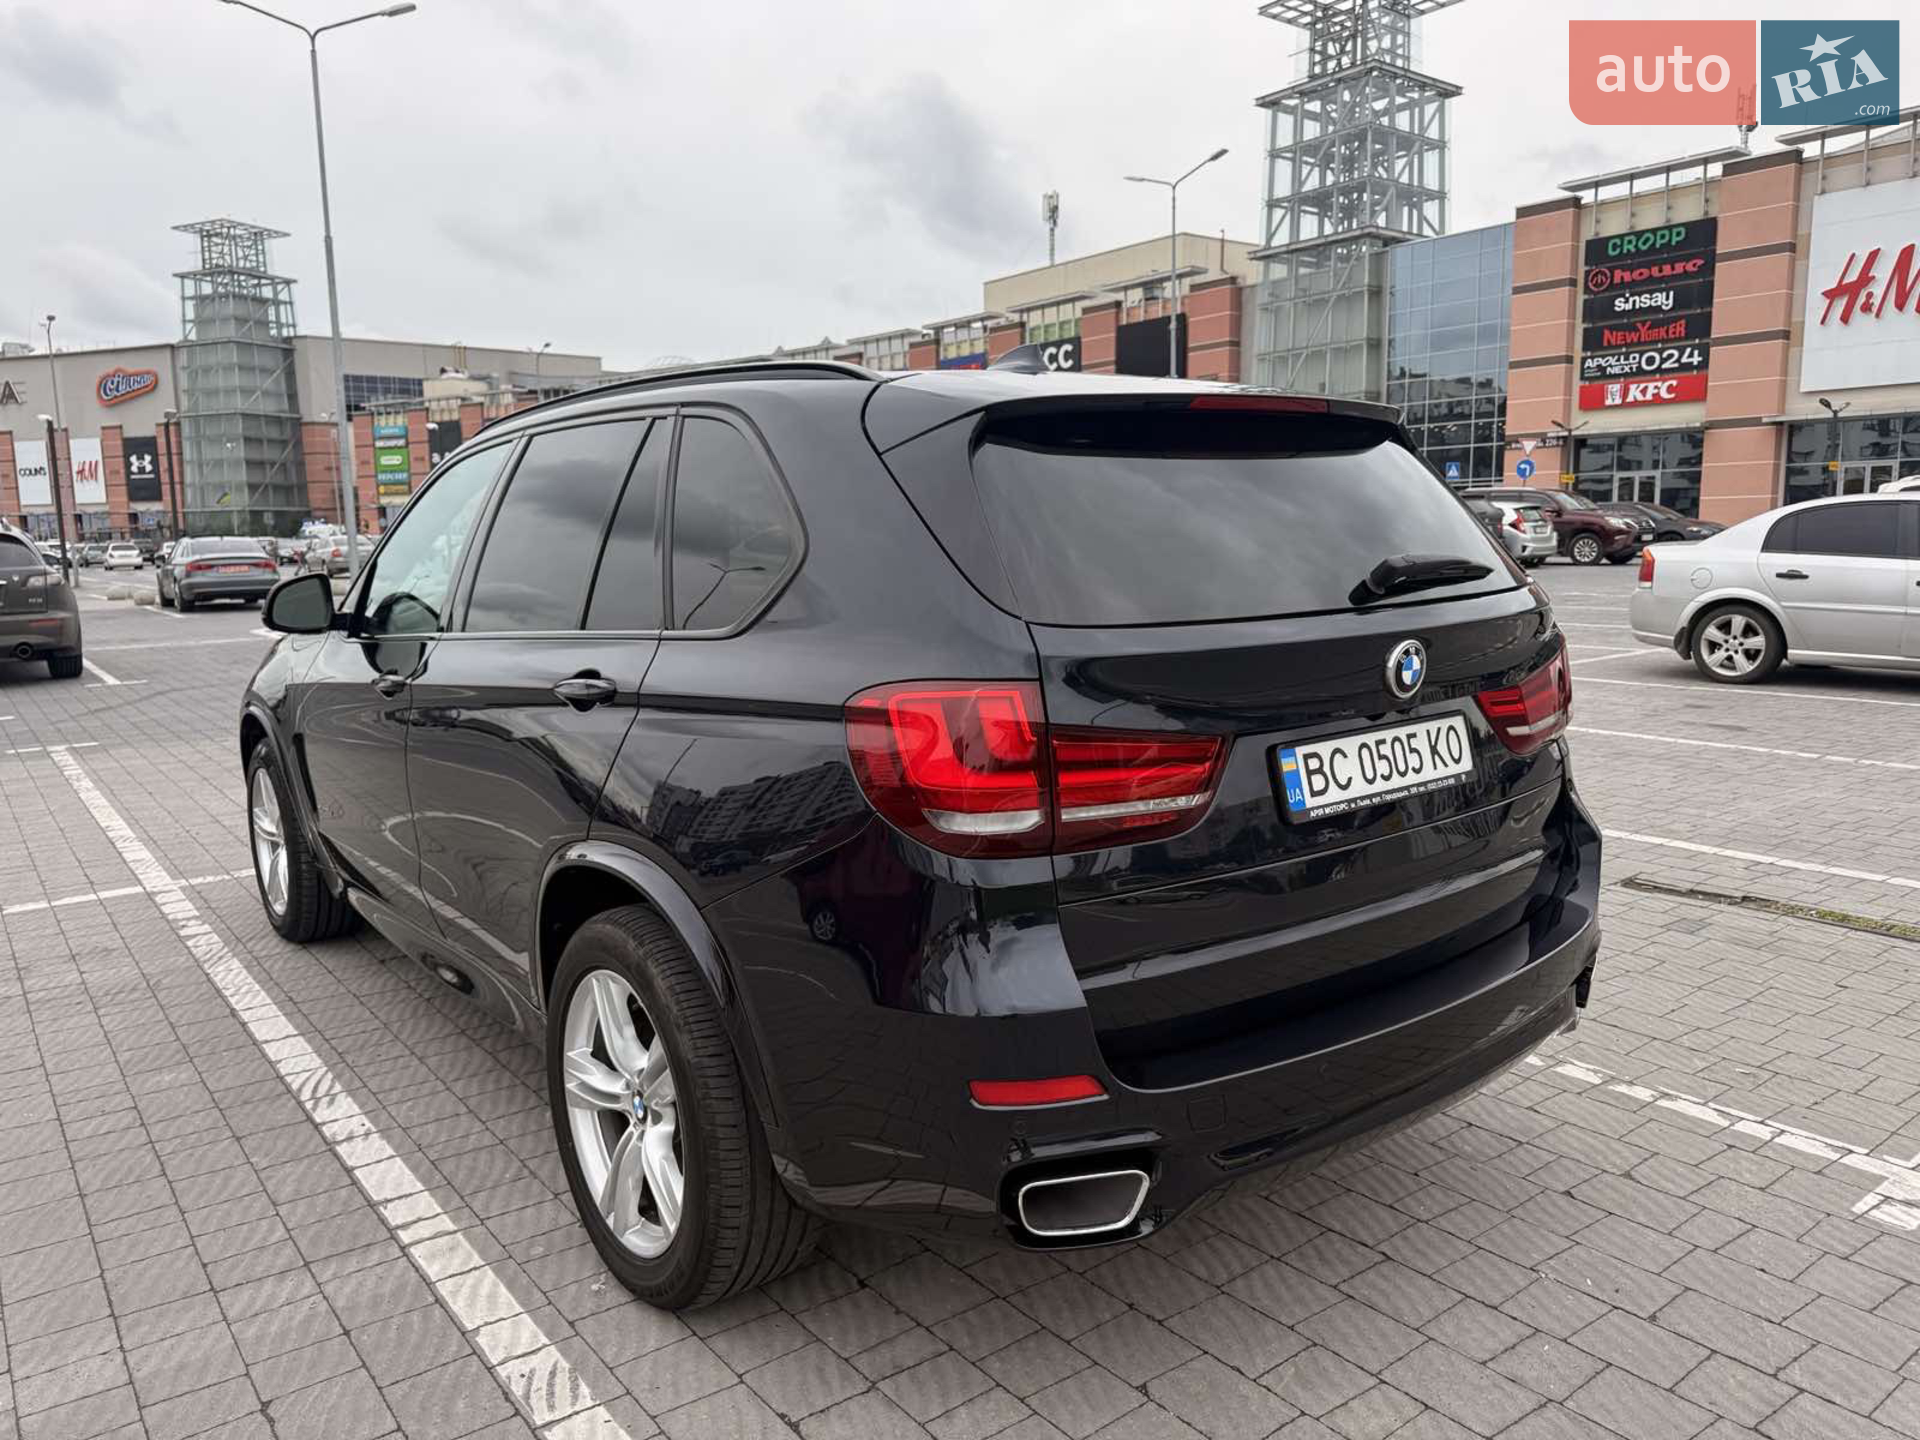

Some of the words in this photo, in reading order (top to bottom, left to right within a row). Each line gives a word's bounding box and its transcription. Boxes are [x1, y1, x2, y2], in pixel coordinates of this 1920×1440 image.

[1608, 227, 1686, 256] CROPP
[1614, 290, 1674, 311] sinsay
[1584, 353, 1640, 369] APOLLO
[1606, 364, 1639, 375] NEXT
[1626, 380, 1678, 402] KFC
[1302, 747, 1353, 798] BC
[1358, 732, 1424, 785] 0505
[1426, 724, 1463, 770] KO
[1287, 787, 1304, 804] UA
